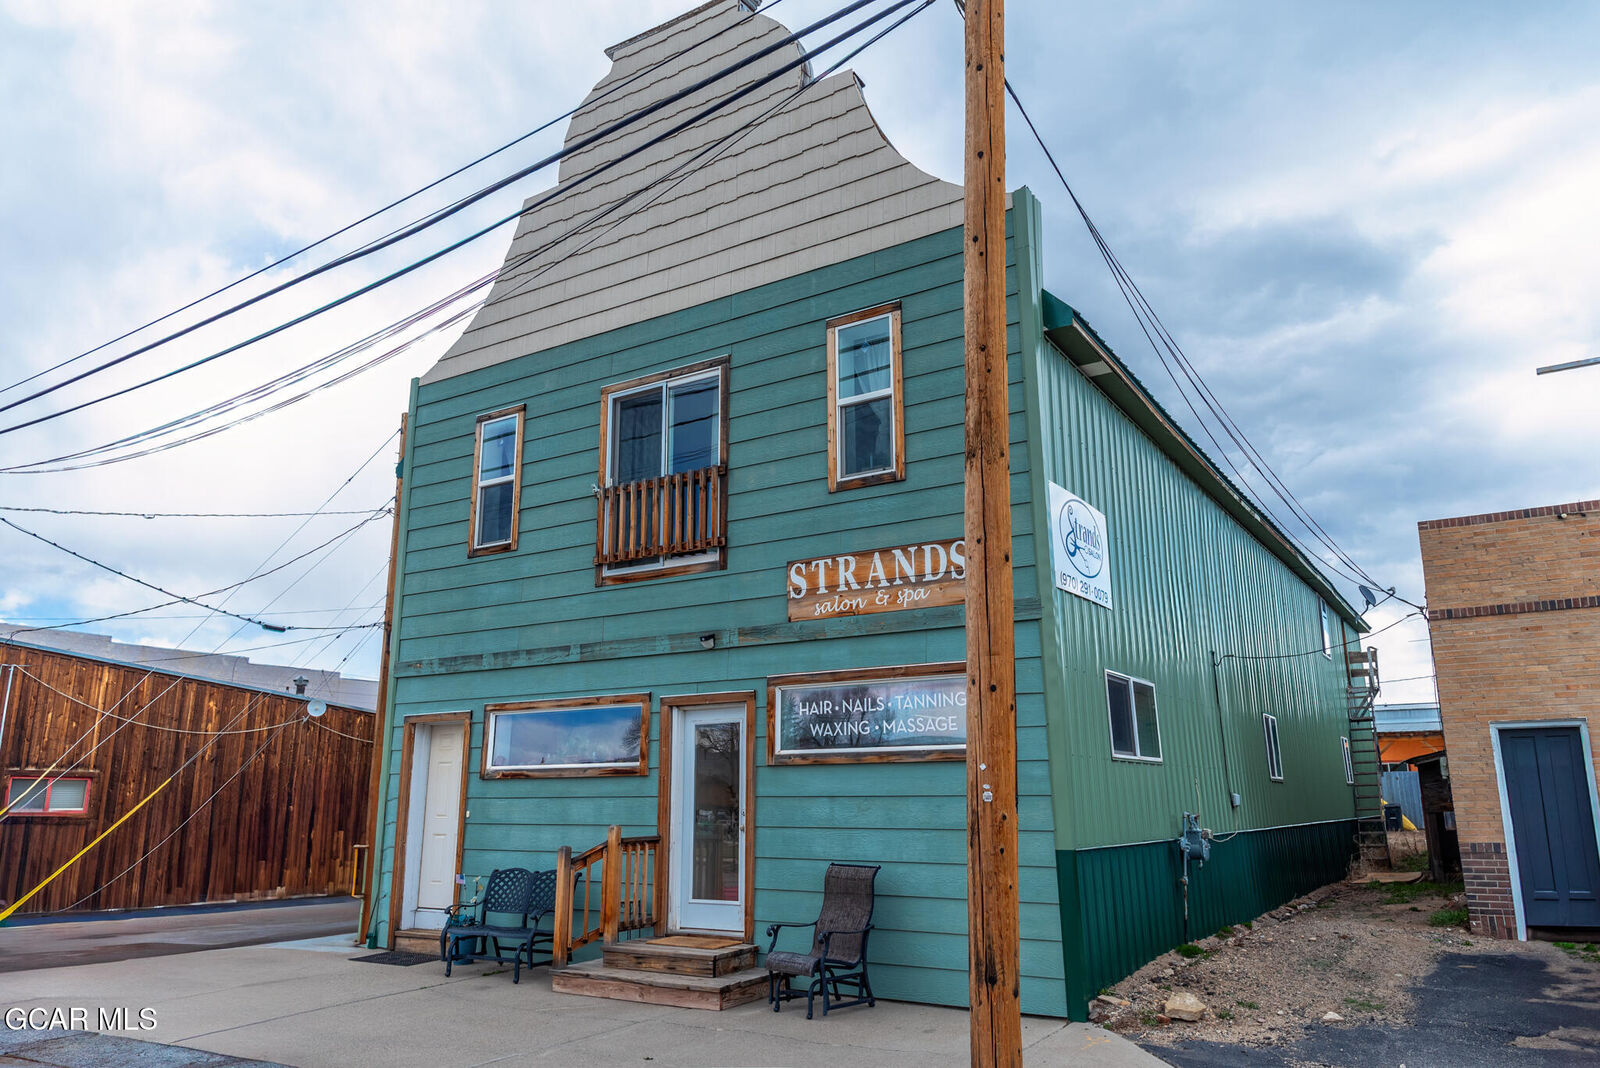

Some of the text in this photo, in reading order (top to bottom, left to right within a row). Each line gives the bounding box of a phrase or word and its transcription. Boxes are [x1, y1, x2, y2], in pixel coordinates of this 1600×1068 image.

[1065, 504, 1100, 557] Strands
[790, 540, 965, 599] STRANDS
[814, 587, 931, 616] salon & spa
[1060, 571, 1109, 604] (970) 291-0079
[799, 691, 966, 716] HAIR NAILS TANNING
[810, 716, 958, 737] WAXING MASSAGE
